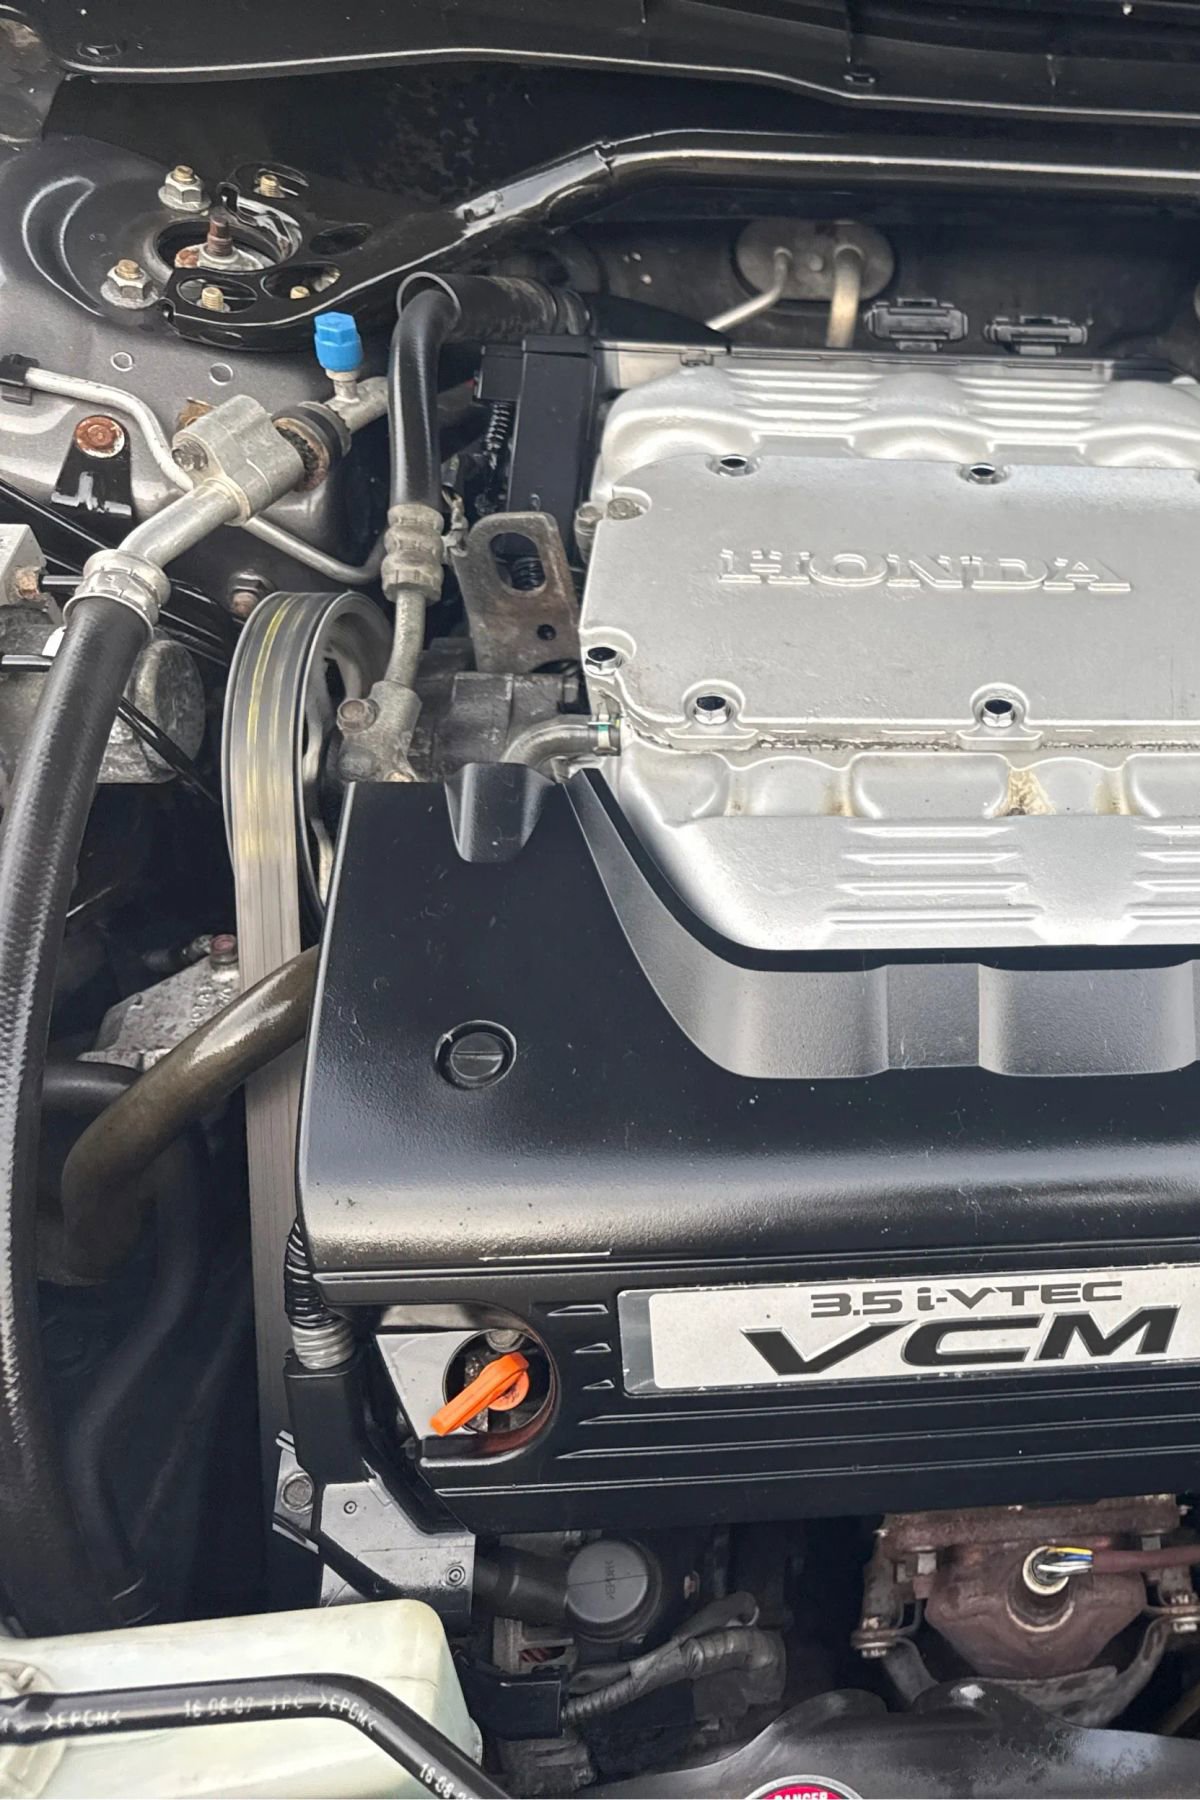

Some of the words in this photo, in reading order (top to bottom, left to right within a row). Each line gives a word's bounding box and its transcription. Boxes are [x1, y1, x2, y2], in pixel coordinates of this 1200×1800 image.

[717, 548, 1131, 592] HONDA
[810, 1286, 902, 1318] 3.5
[917, 1280, 1123, 1312] i-VTEC
[739, 1304, 1182, 1376] VCM
